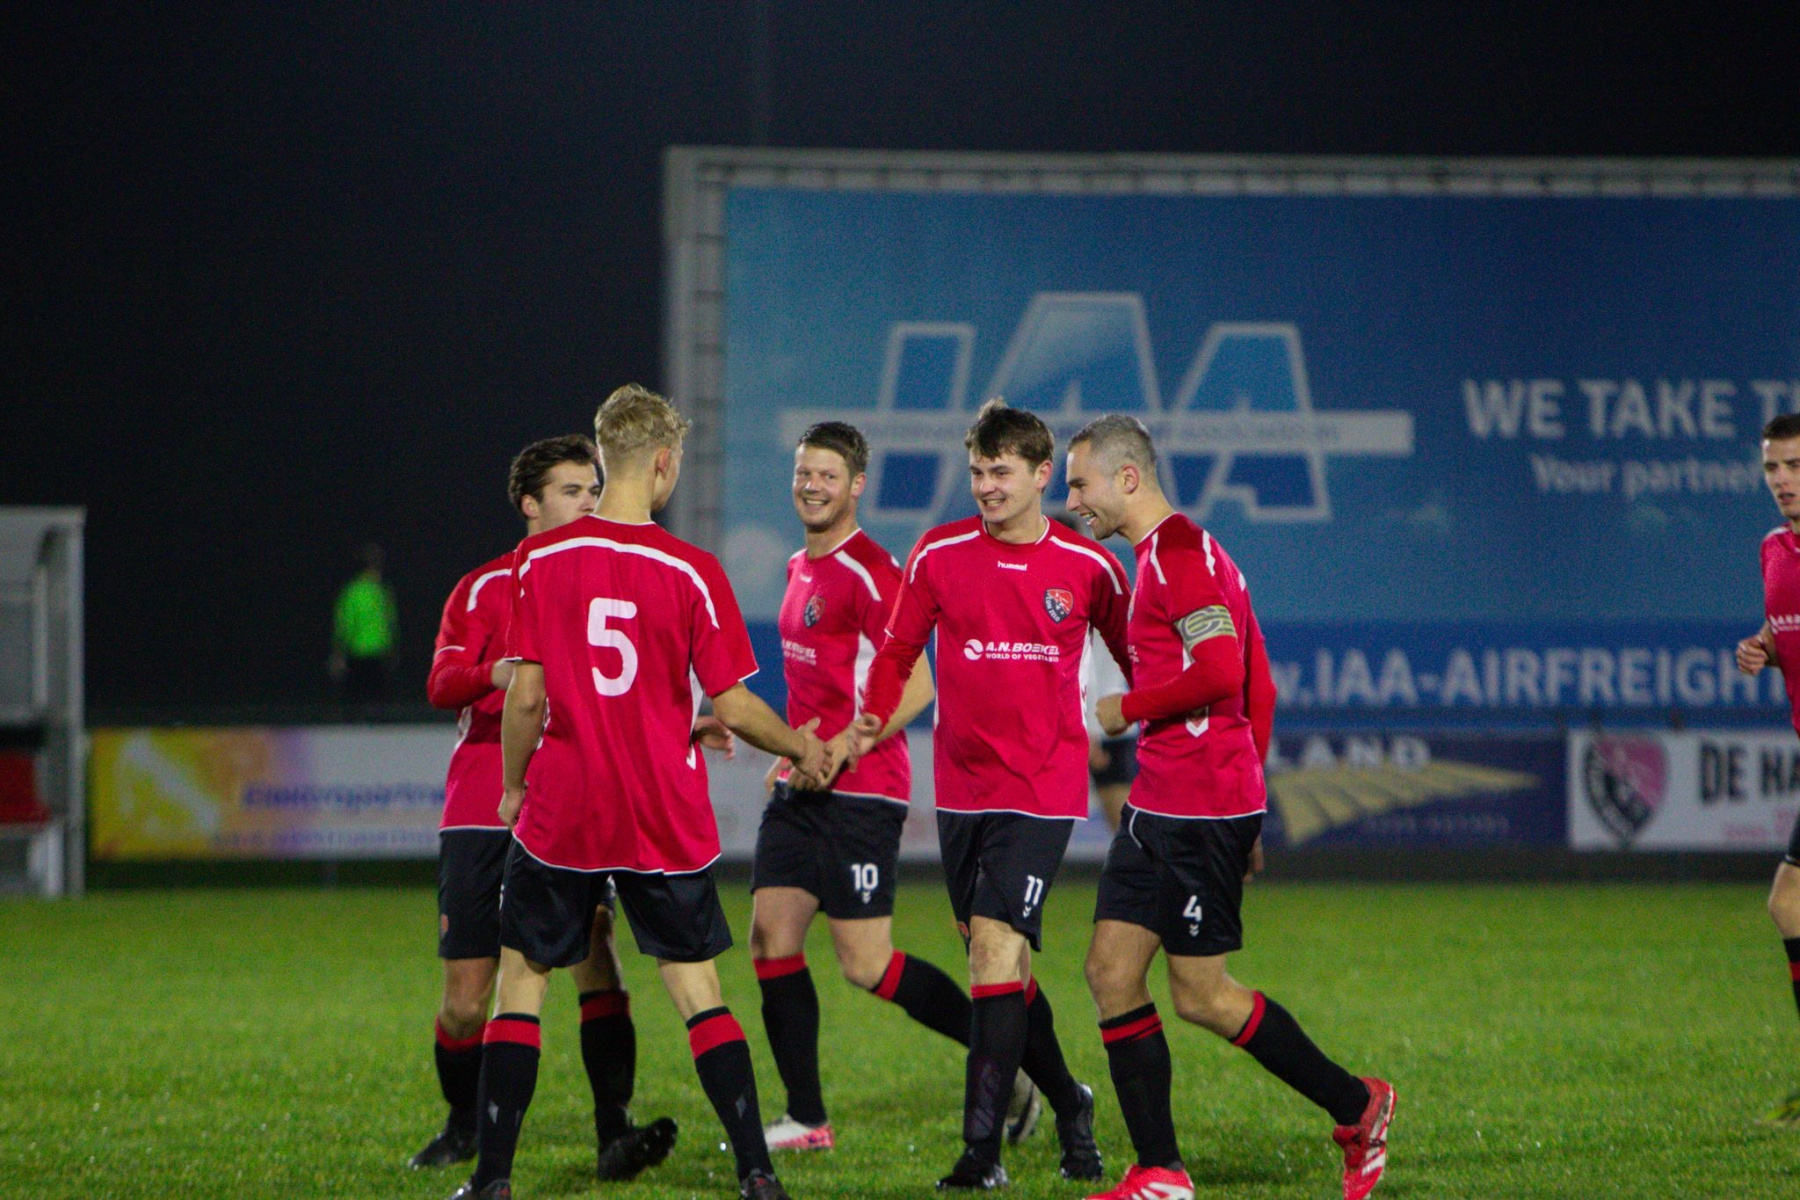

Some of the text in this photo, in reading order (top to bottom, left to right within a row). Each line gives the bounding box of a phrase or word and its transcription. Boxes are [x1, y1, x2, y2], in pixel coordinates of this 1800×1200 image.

[1462, 379, 1800, 438] WE TAKE T
[1530, 453, 1618, 493] Your
[997, 560, 1028, 571] hummel
[587, 597, 639, 697] 5
[985, 652, 1010, 661] WORLD
[1700, 743, 1748, 803] DE
[851, 863, 879, 891] 10
[1024, 874, 1044, 906] 11
[1182, 894, 1203, 922] 4
